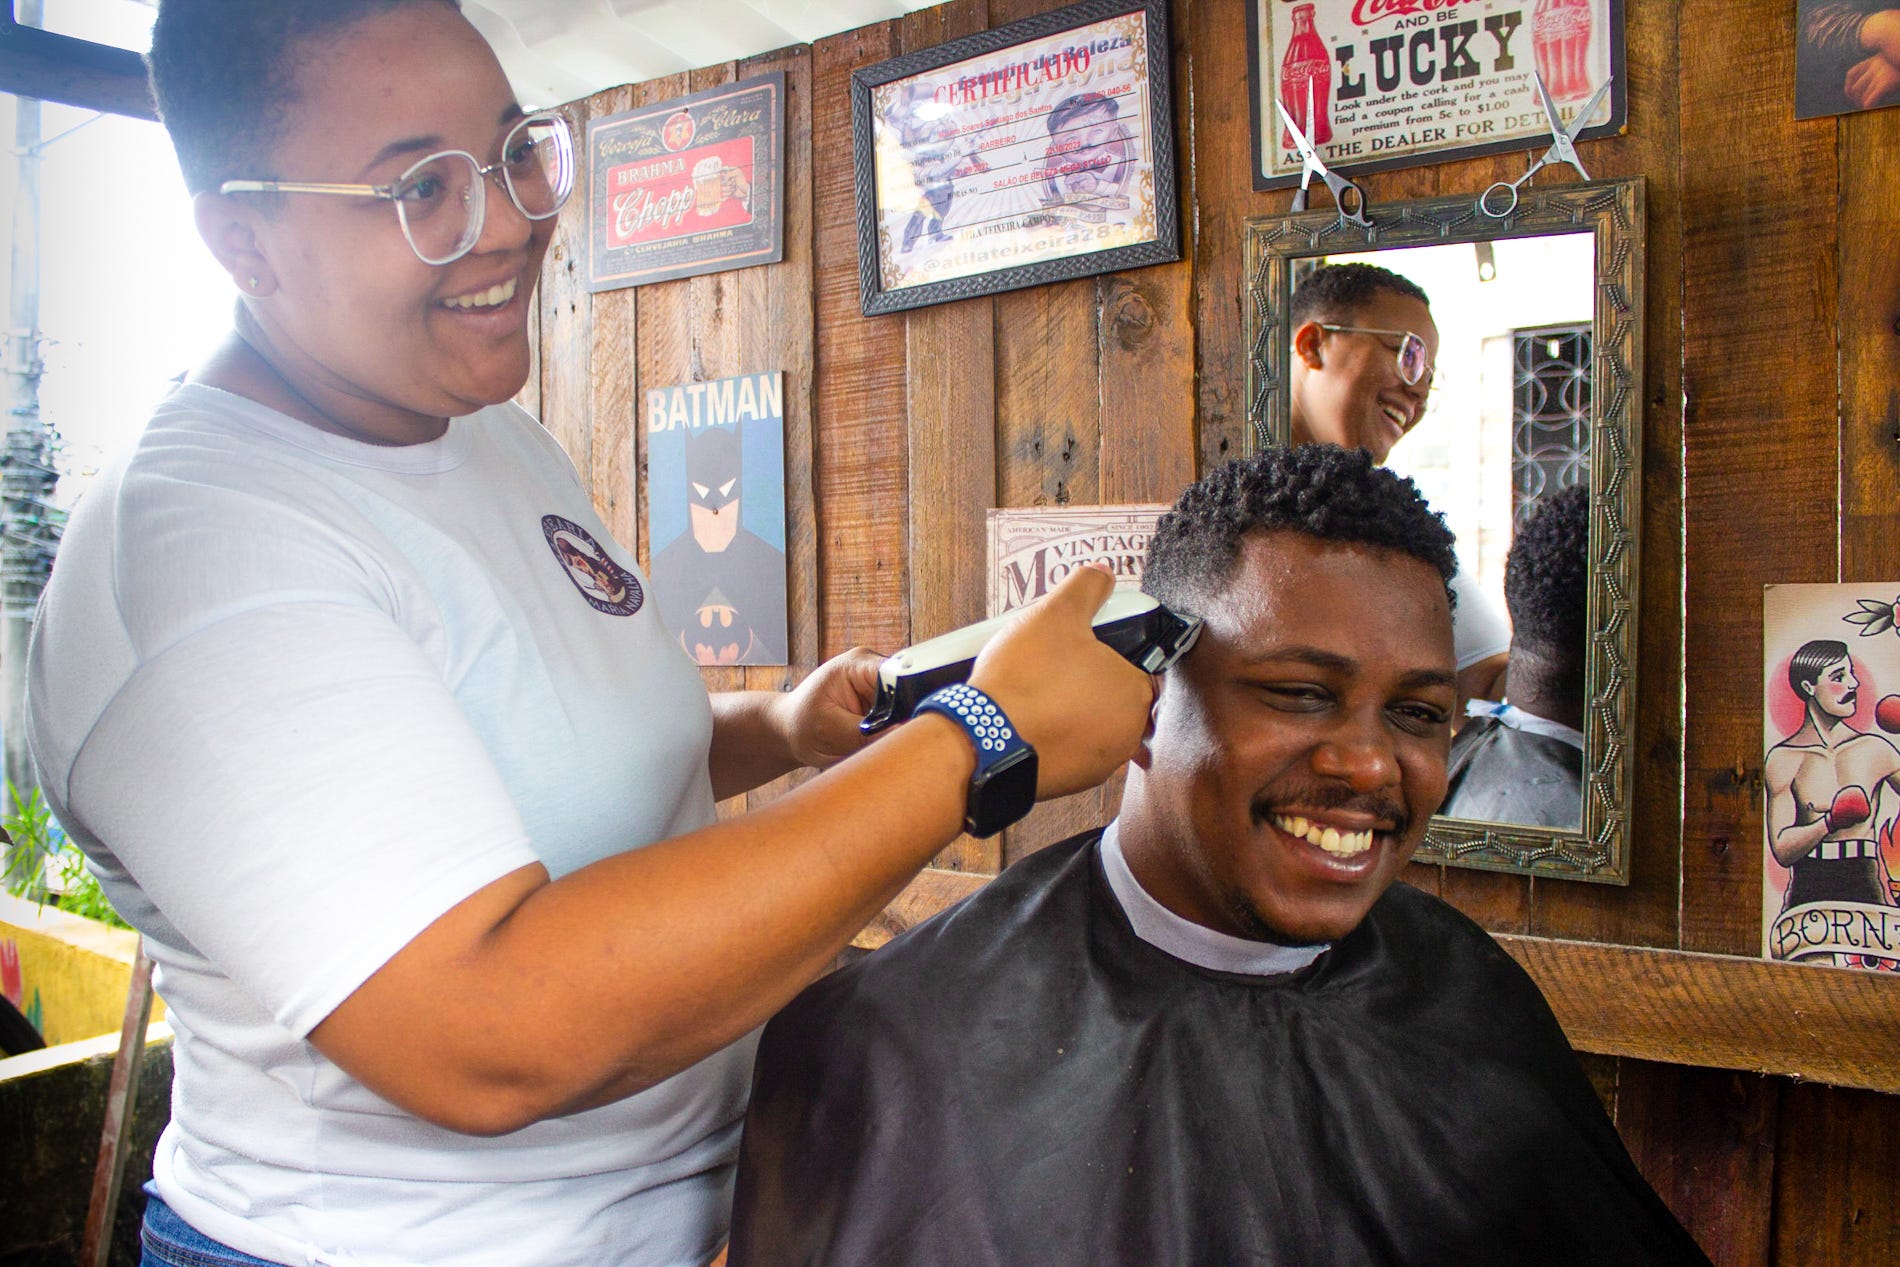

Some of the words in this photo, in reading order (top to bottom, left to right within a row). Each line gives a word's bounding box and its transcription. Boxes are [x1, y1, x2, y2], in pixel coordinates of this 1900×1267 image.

[1394, 15, 1429, 31] AND
[1436, 9, 1458, 22] BE
[1334, 11, 1523, 101] LUCKY
[933, 48, 1091, 108] CERTIFICADO
[1334, 99, 1361, 112] Look
[1366, 94, 1397, 107] under
[1401, 90, 1419, 100] the
[1423, 85, 1449, 97] cork
[1453, 79, 1475, 91] and
[1478, 76, 1500, 88] you
[1504, 72, 1530, 84] may
[711, 107, 762, 131] Clara
[1334, 112, 1356, 125] find
[1375, 106, 1414, 119] coupon
[1421, 94, 1457, 110] calling
[1463, 91, 1482, 103] for
[1504, 84, 1530, 96] cash
[1352, 120, 1400, 136] premium
[1405, 113, 1433, 125] from
[1459, 108, 1471, 117] to
[1477, 99, 1511, 114] $1.00
[979, 135, 1016, 151] BARBEIRO
[1283, 147, 1316, 166] AS
[1326, 141, 1363, 158] THE
[1371, 127, 1447, 152] DEALER
[1456, 120, 1495, 138] FOR
[1504, 104, 1586, 130] DETIL
[617, 156, 687, 187] BRAHMA
[1018, 172, 1029, 183] DE
[1030, 165, 1058, 181] BELEZA
[613, 184, 696, 240] Chopp
[692, 229, 734, 244] BRAHMA
[646, 372, 783, 434] BATMAN
[1776, 908, 1893, 960] BORN
